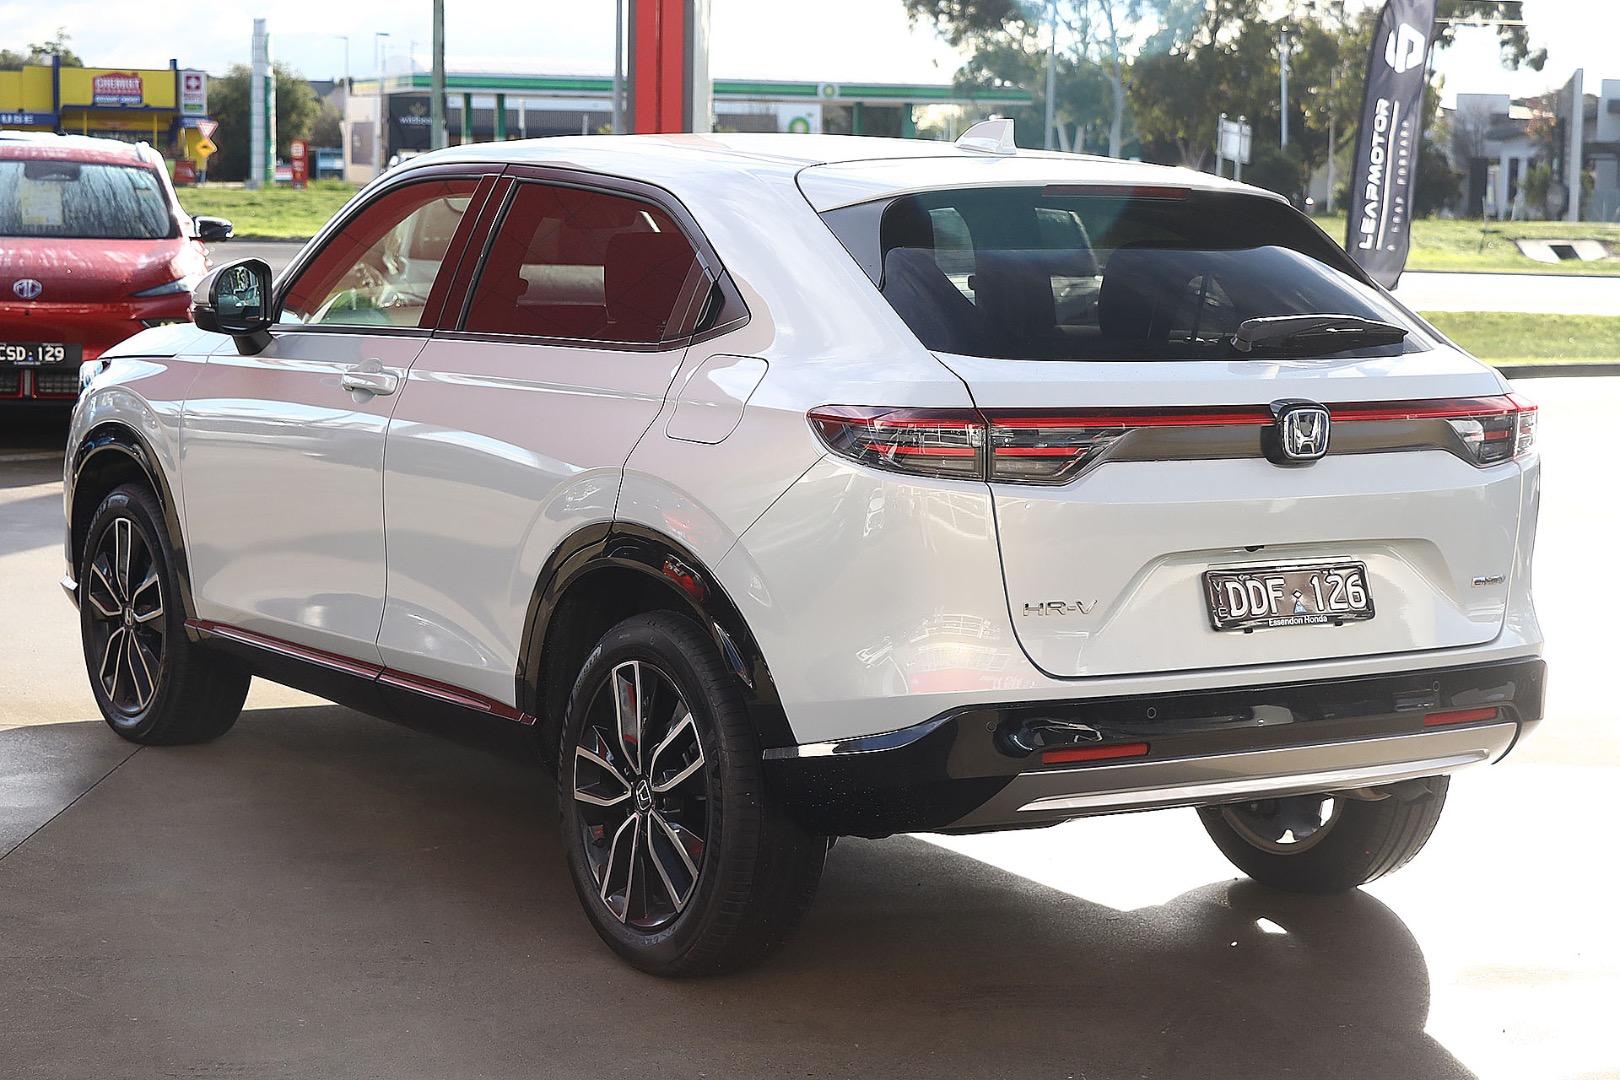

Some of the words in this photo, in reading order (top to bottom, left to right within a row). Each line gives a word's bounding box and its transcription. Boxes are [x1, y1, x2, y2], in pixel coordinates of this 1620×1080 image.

[1358, 97, 1391, 250] LEAPMOTOR
[38, 346, 65, 362] 129
[1023, 600, 1098, 616] HR-V
[1212, 581, 1229, 618] VIC
[1225, 577, 1285, 617] DDF
[1310, 574, 1367, 612] 126
[1268, 615, 1304, 627] Essendon
[1304, 614, 1328, 625] Honda
